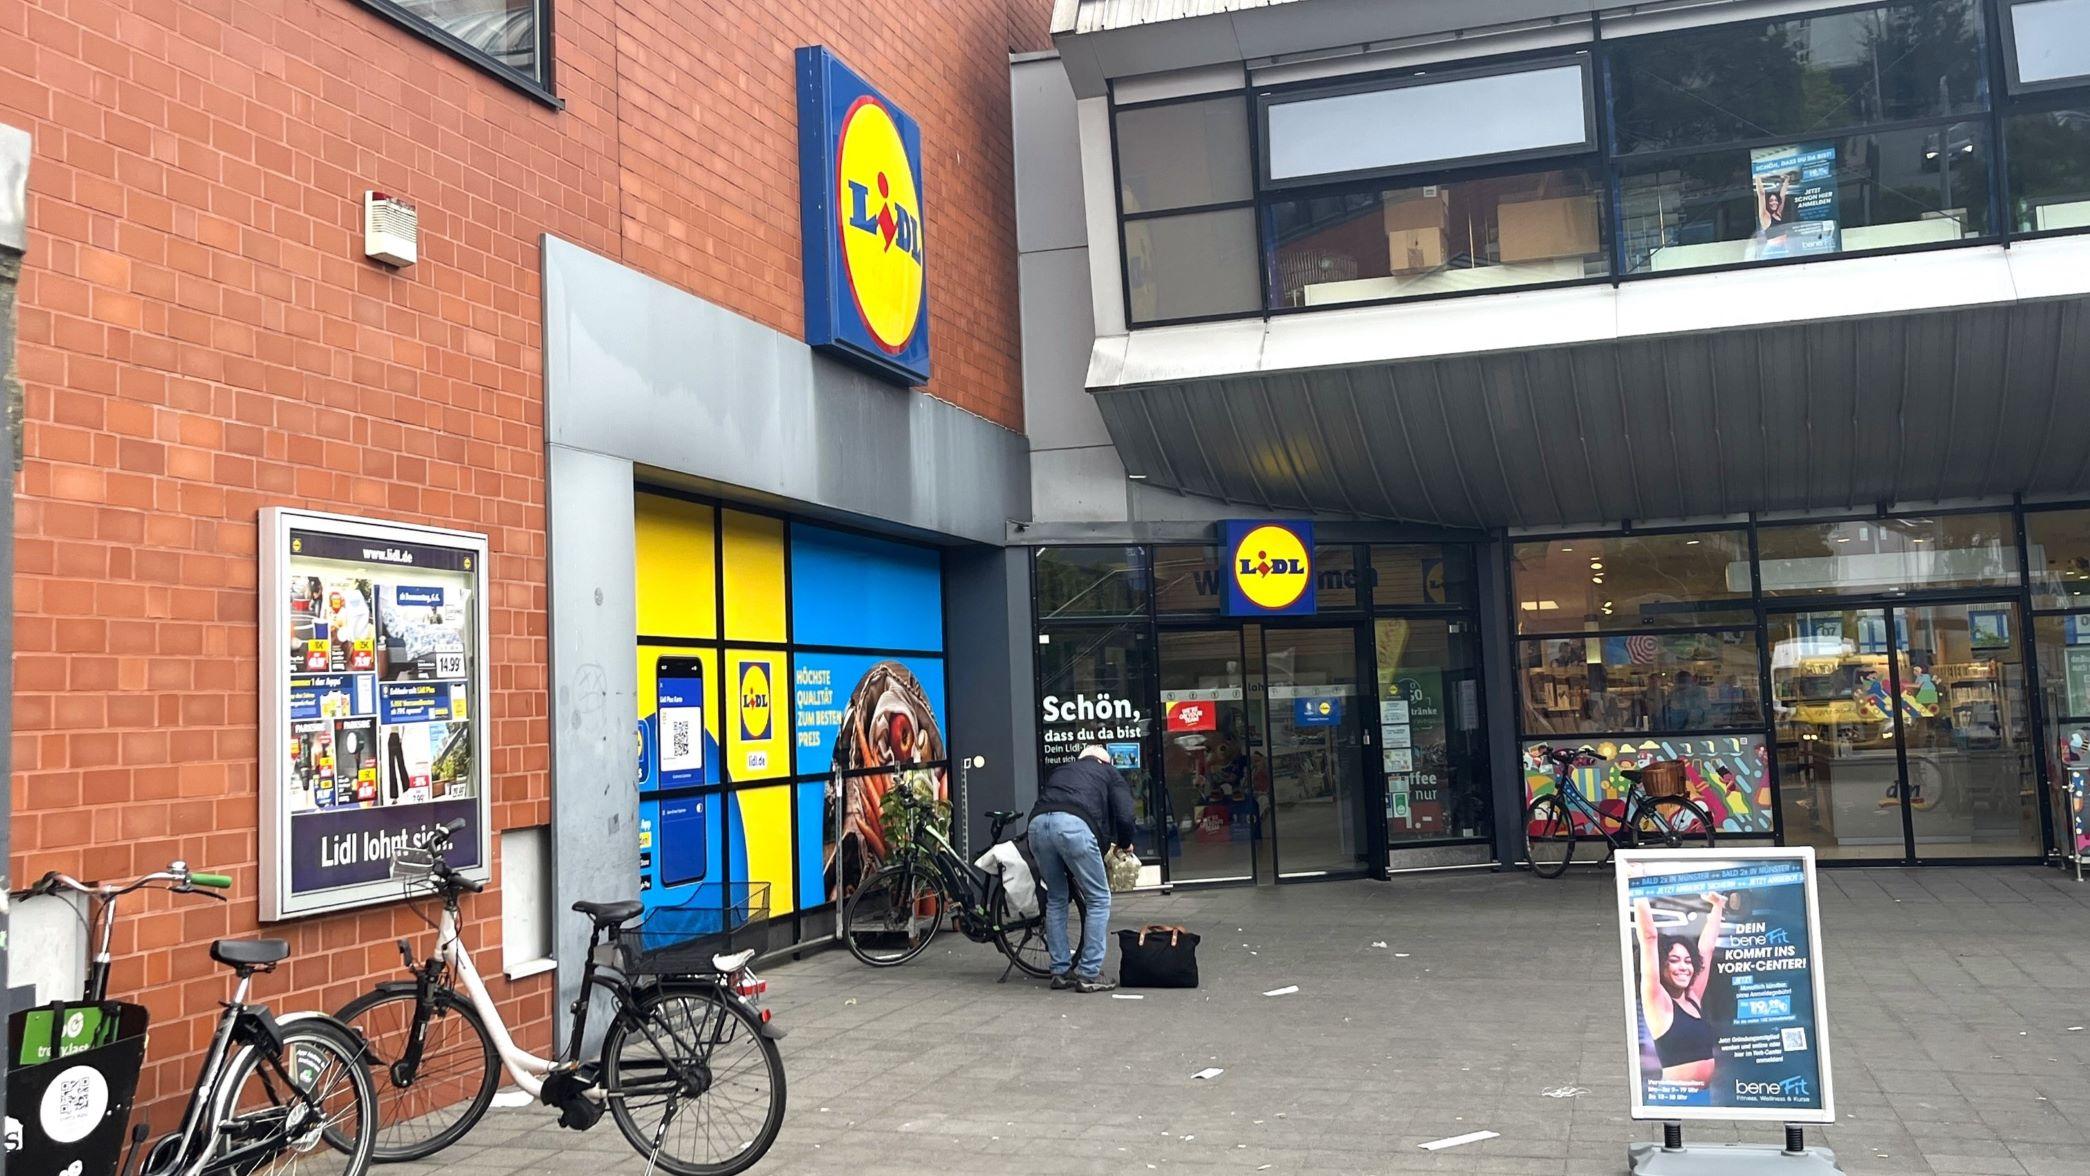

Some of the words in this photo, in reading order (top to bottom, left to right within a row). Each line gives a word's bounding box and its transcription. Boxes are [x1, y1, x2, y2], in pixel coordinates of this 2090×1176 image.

[1798, 198, 1832, 208] ANMELDEN
[363, 547, 413, 564] www.lidl.de
[797, 666, 831, 685] HÖCHSTE
[797, 687, 833, 709] QUALITÄT
[1043, 693, 1140, 722] Schön,
[798, 710, 815, 726] ZUM
[816, 710, 842, 725] BESTEN
[798, 731, 820, 747] PREIS
[1044, 730, 1074, 742] dass
[1077, 728, 1094, 740] du
[1098, 727, 1114, 740] da
[1116, 726, 1141, 738] bist
[1044, 744, 1063, 754] Dein
[748, 755, 766, 767] lidl.de
[1045, 756, 1061, 764] freut
[1062, 755, 1076, 763] sich
[1415, 790, 1438, 800] nur
[322, 832, 357, 868] Lidl
[364, 828, 409, 862] lohnt
[1642, 876, 1658, 886] BALD
[1669, 875, 1677, 884] IN
[1678, 871, 1710, 882] MÜNSTER
[1722, 869, 1738, 878] BALD
[1750, 868, 1757, 876] IN
[1758, 864, 1790, 875] MÜNSTER
[1656, 886, 1675, 895] JETZT
[1749, 876, 1766, 886] JETZT
[1736, 922, 1766, 934] DEIN
[1725, 947, 1772, 960] KOMMT
[1774, 946, 1796, 956] INS
[1717, 958, 1806, 974] YORK-CENTER!
